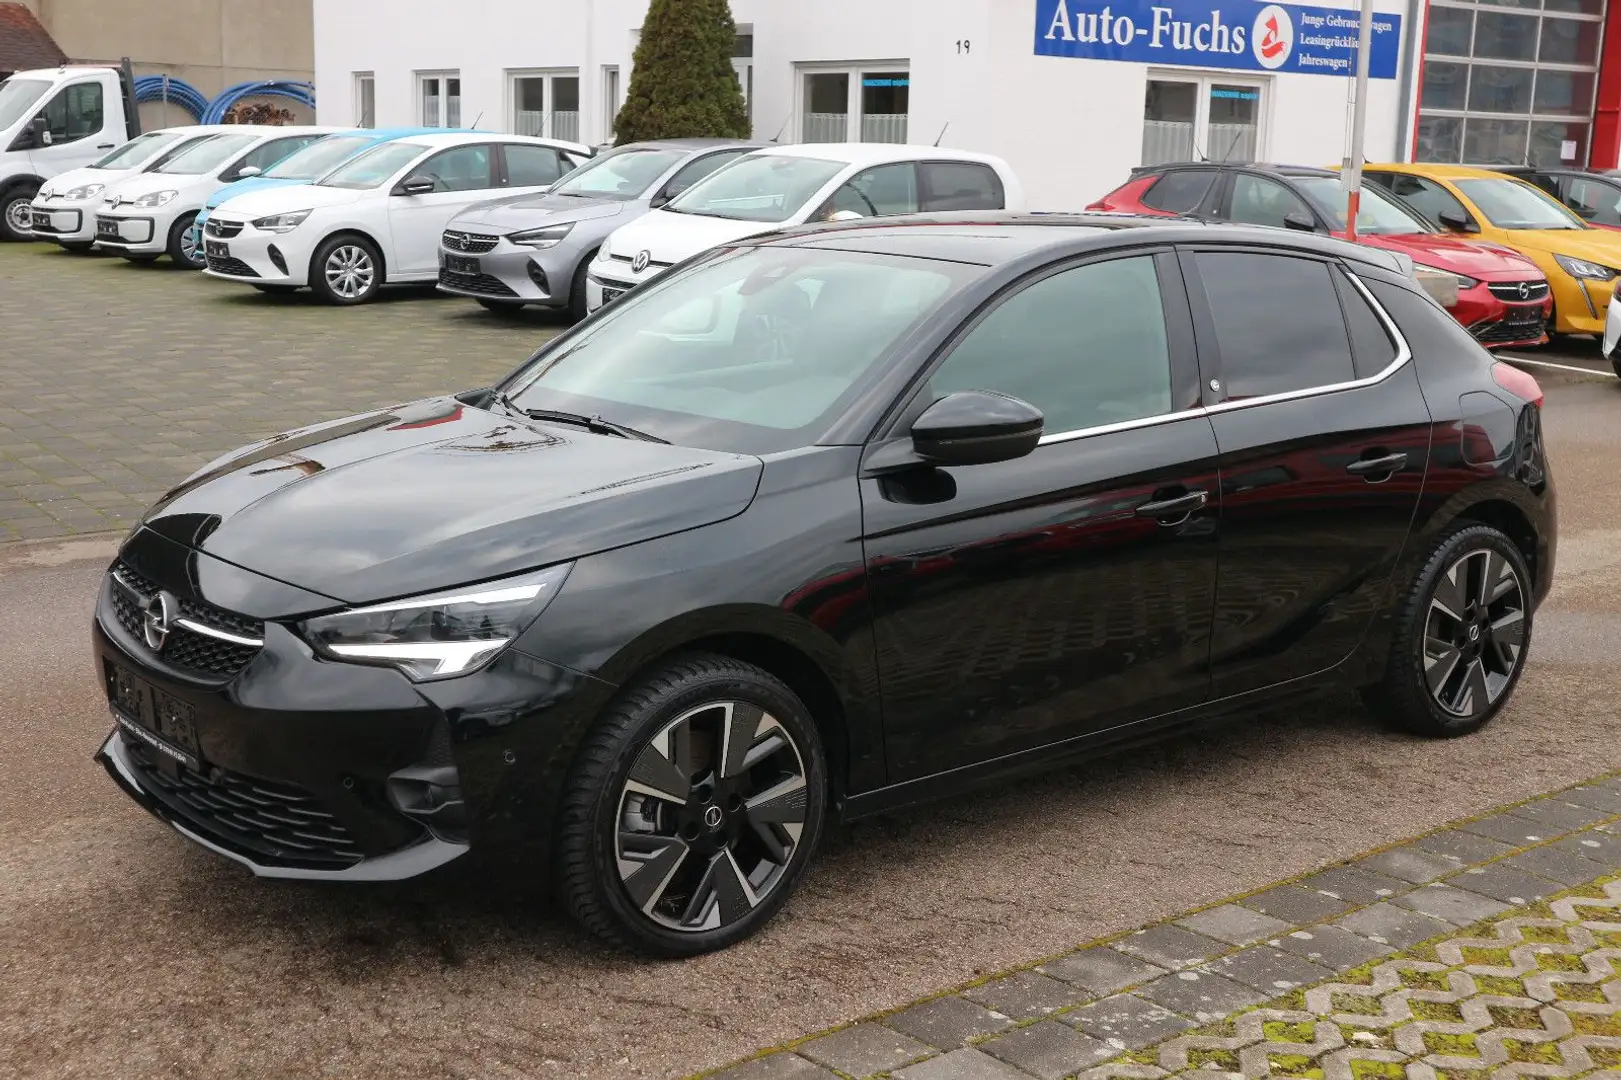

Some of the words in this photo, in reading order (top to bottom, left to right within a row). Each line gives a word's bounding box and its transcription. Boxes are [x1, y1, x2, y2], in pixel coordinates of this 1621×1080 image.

[1044, 0, 1246, 54] Auto-Fuchs
[1301, 12, 1324, 28] Junge
[1326, 14, 1392, 34] Gebraucagen
[956, 39, 970, 54] 19
[1298, 53, 1348, 70] Jahreswagen
